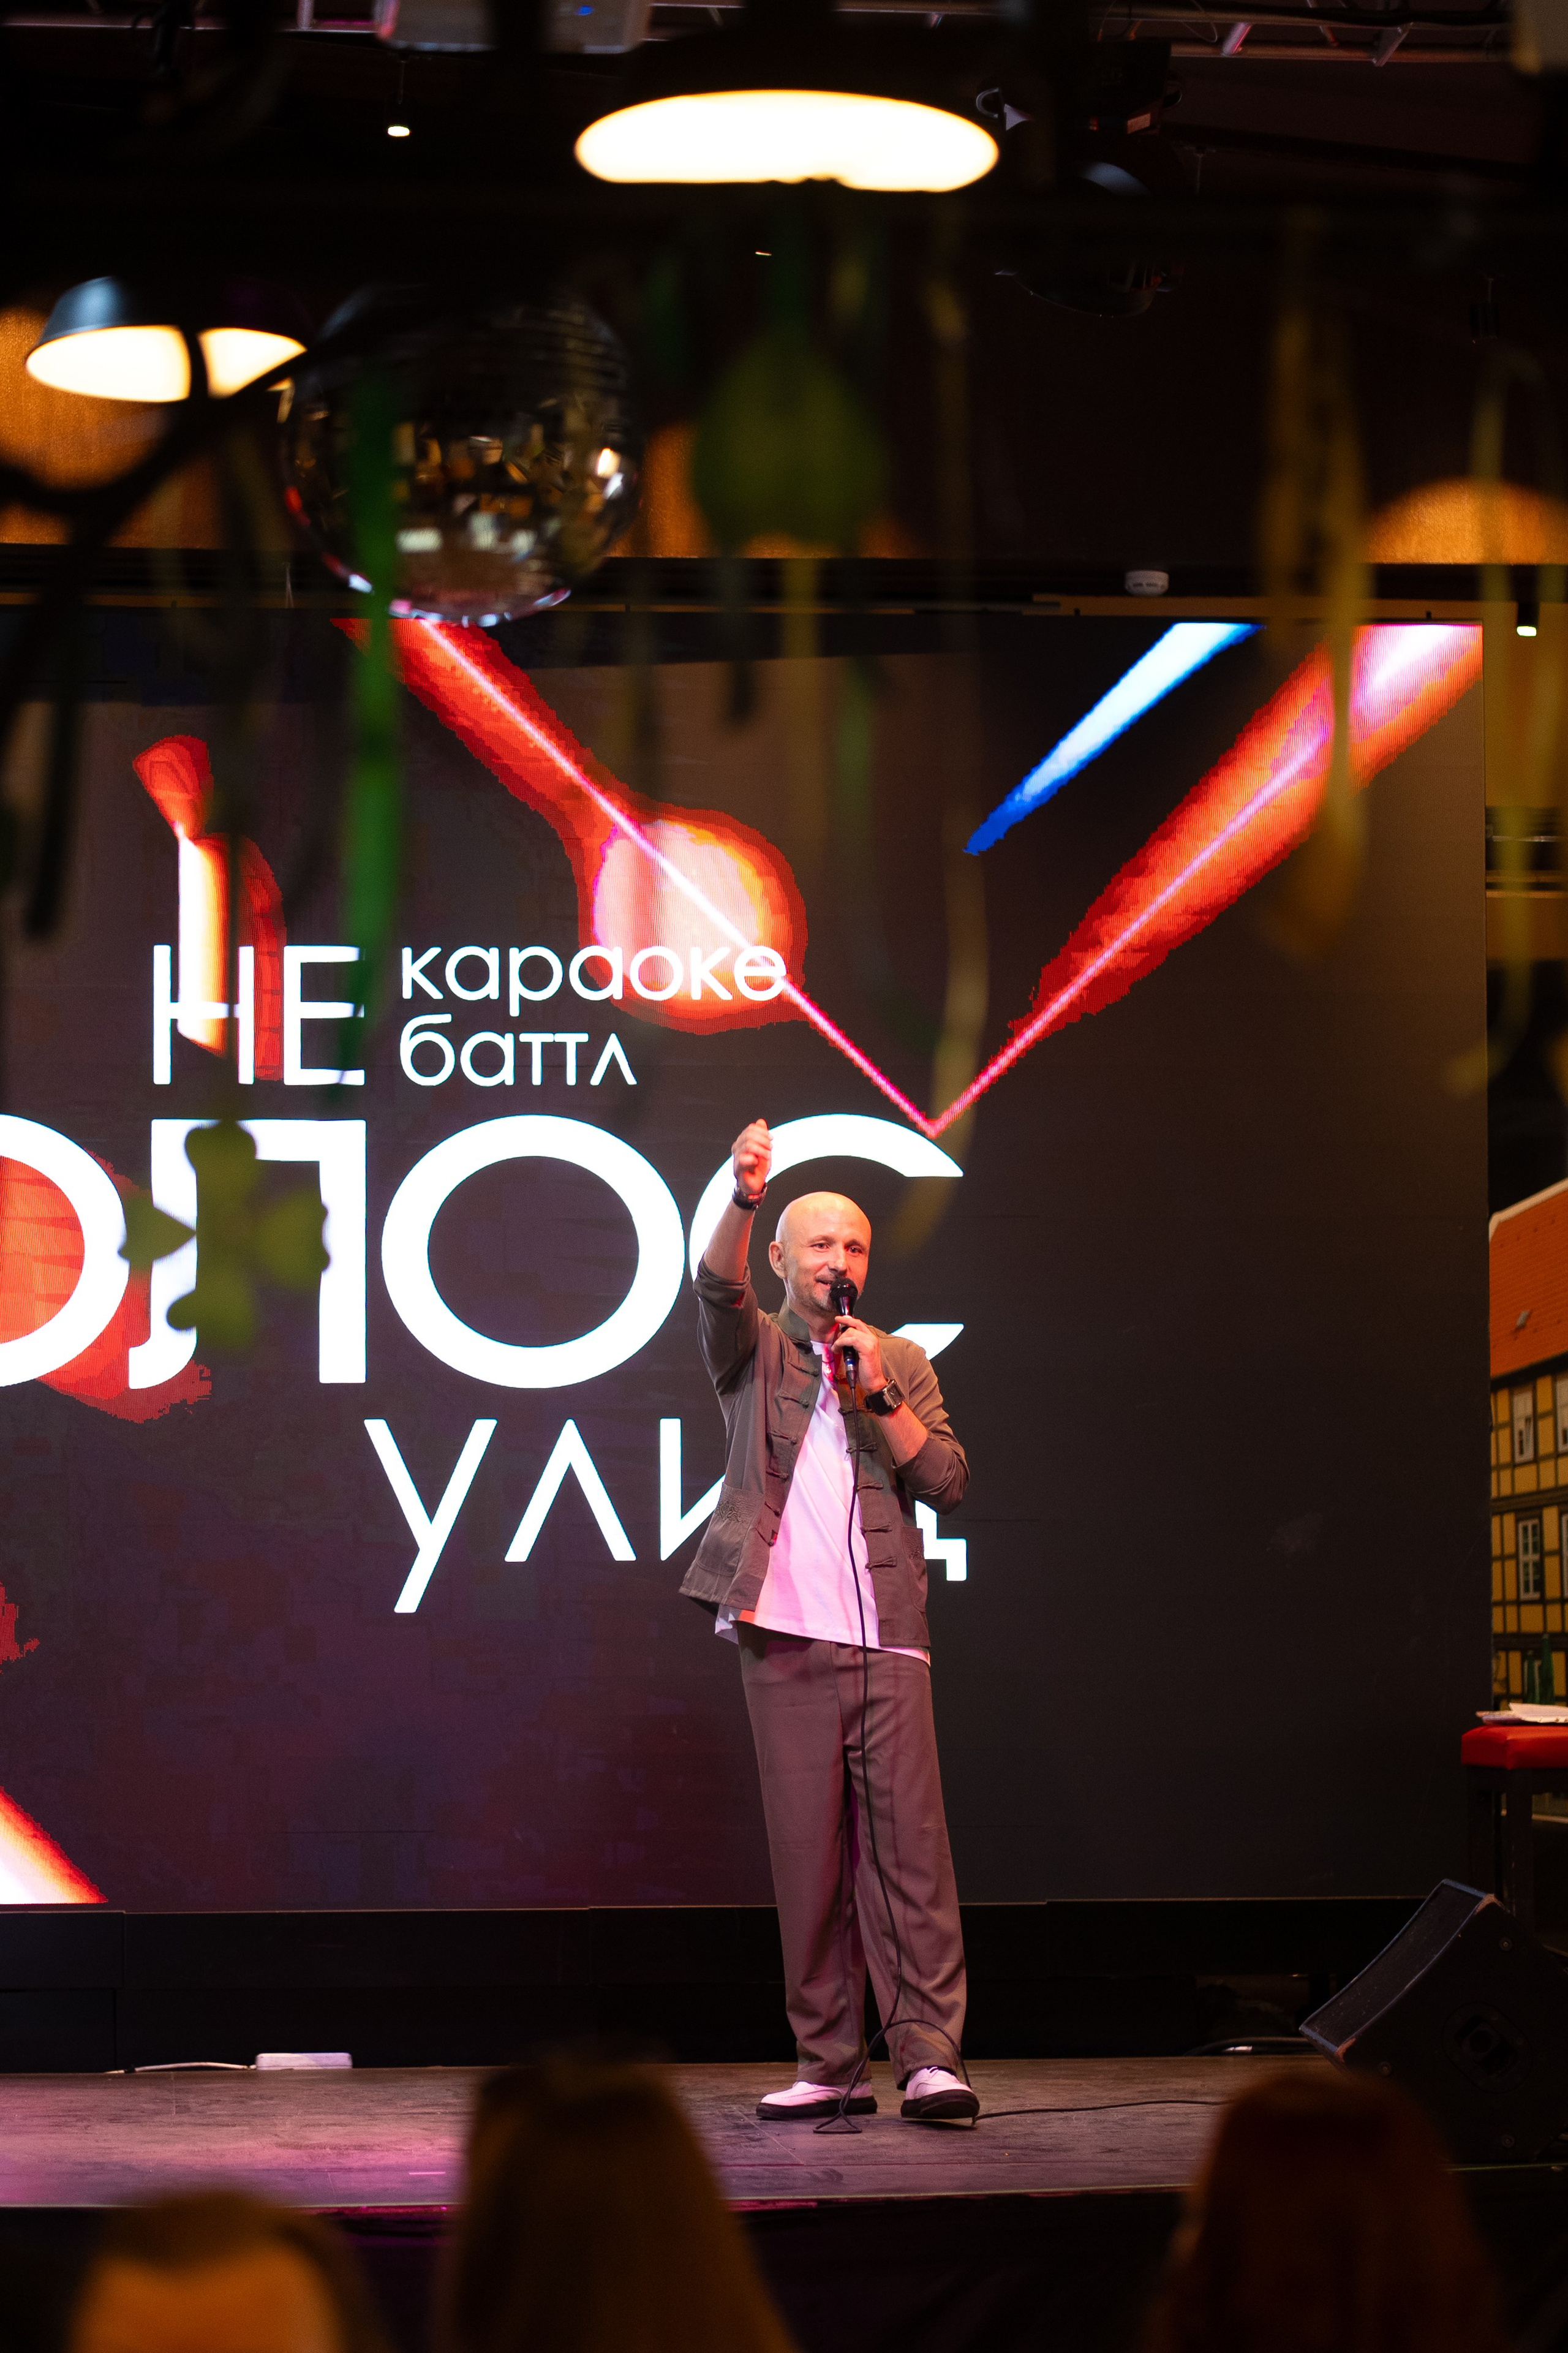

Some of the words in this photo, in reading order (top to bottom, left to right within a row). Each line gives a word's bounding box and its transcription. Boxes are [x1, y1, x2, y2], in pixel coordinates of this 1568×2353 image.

[154, 945, 364, 1086] НЕ
[402, 945, 786, 1017] караоке
[399, 1014, 637, 1087] баттл
